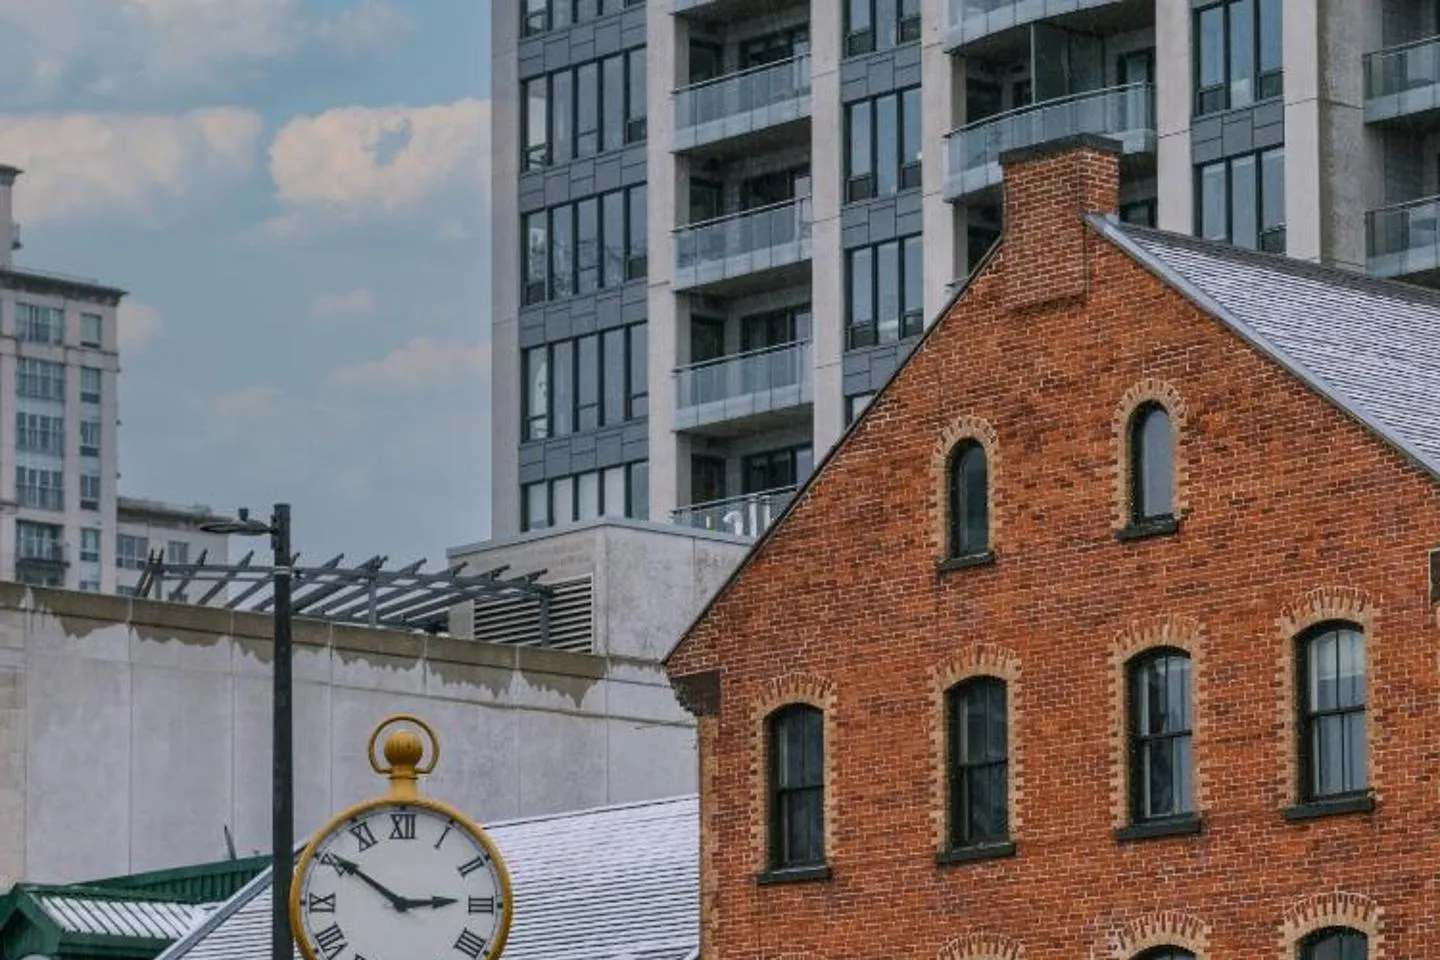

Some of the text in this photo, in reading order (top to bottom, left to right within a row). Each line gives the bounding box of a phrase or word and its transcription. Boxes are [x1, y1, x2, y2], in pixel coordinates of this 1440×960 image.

[348, 821, 378, 852] XI
[390, 813, 417, 840] XII
[434, 824, 452, 849] I
[457, 855, 485, 878] II
[308, 892, 336, 914] IX
[468, 895, 494, 915] III
[452, 927, 486, 960] IIII
